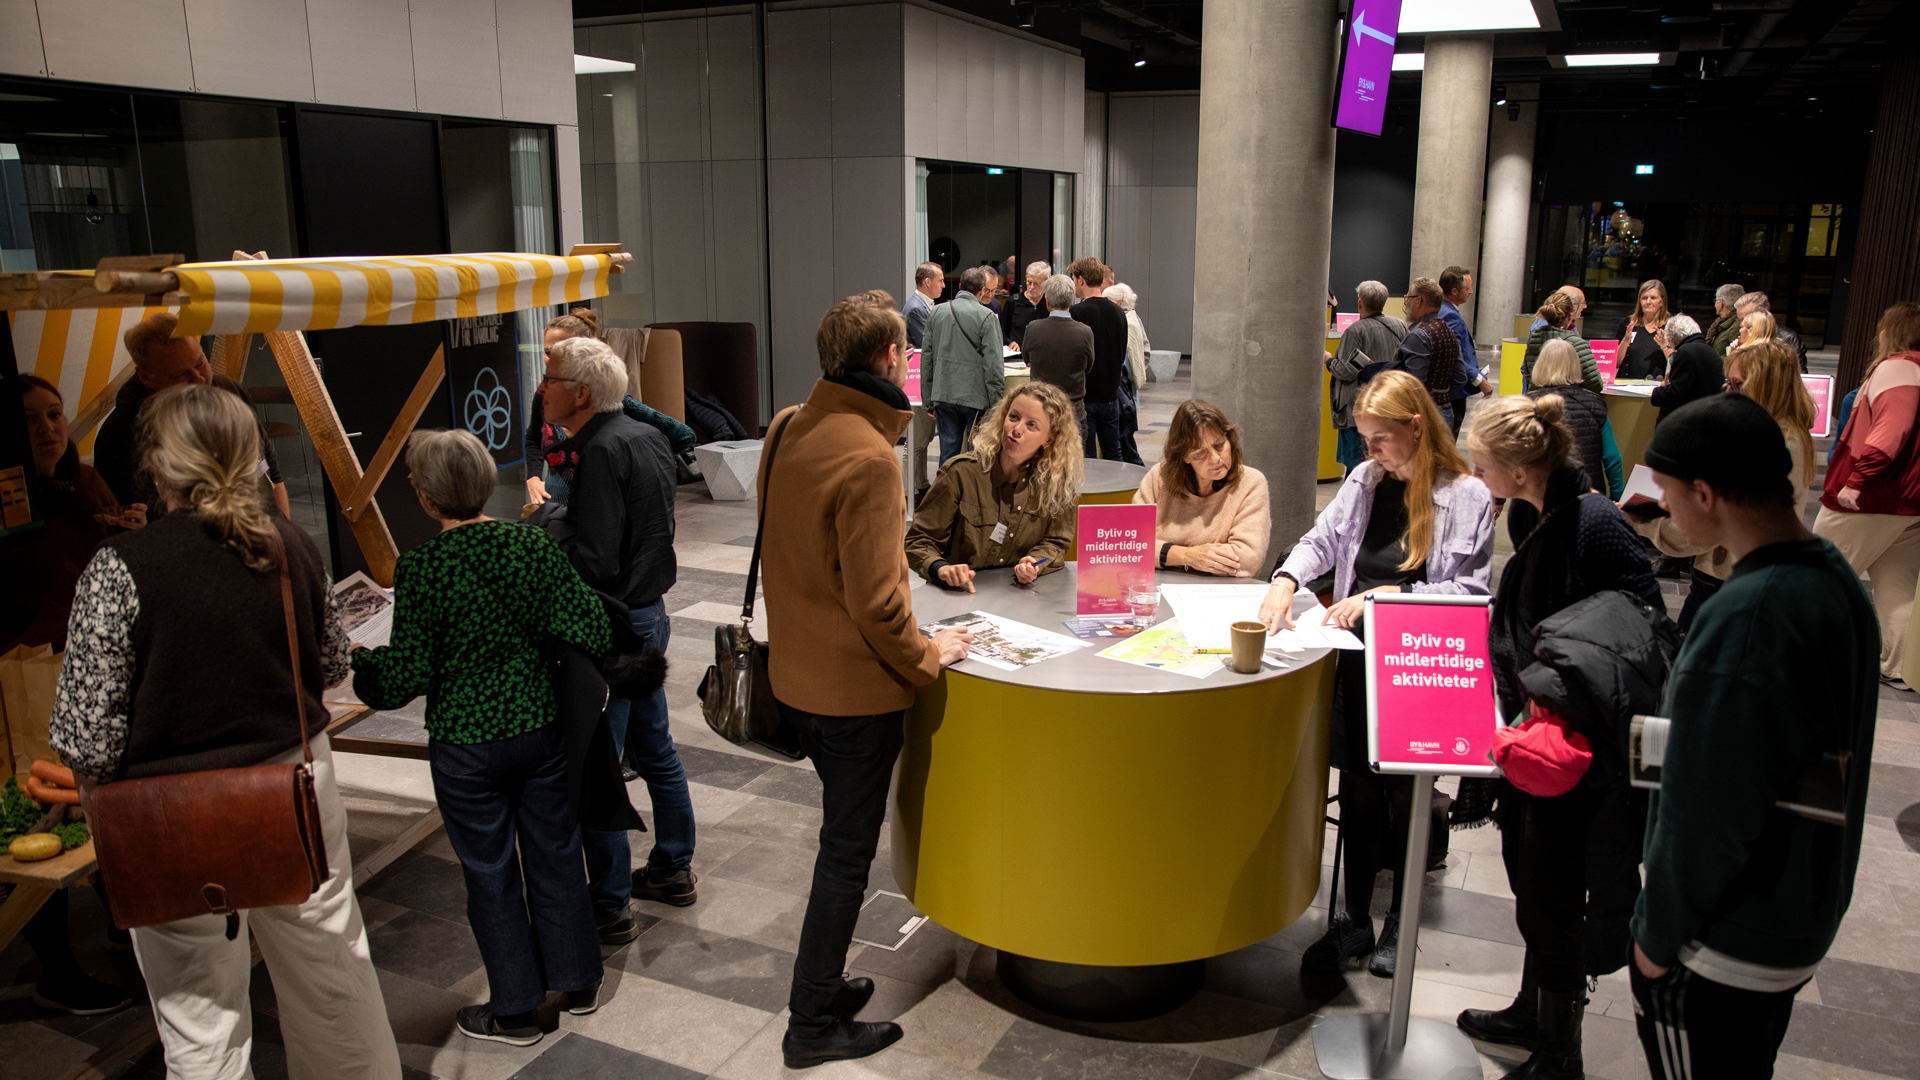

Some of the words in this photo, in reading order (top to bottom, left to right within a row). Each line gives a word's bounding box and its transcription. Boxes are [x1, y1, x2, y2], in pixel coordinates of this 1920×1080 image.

[1097, 528, 1122, 539] Byliv
[1125, 529, 1137, 539] og
[1085, 541, 1148, 552] midlertidige
[1090, 554, 1143, 564] aktiviteter
[1401, 633, 1442, 650] Byliv
[1445, 637, 1465, 651] og
[1384, 652, 1484, 671] midlertidige
[1392, 672, 1478, 688] aktiviteter
[1409, 741, 1440, 749] BY&HAVN
